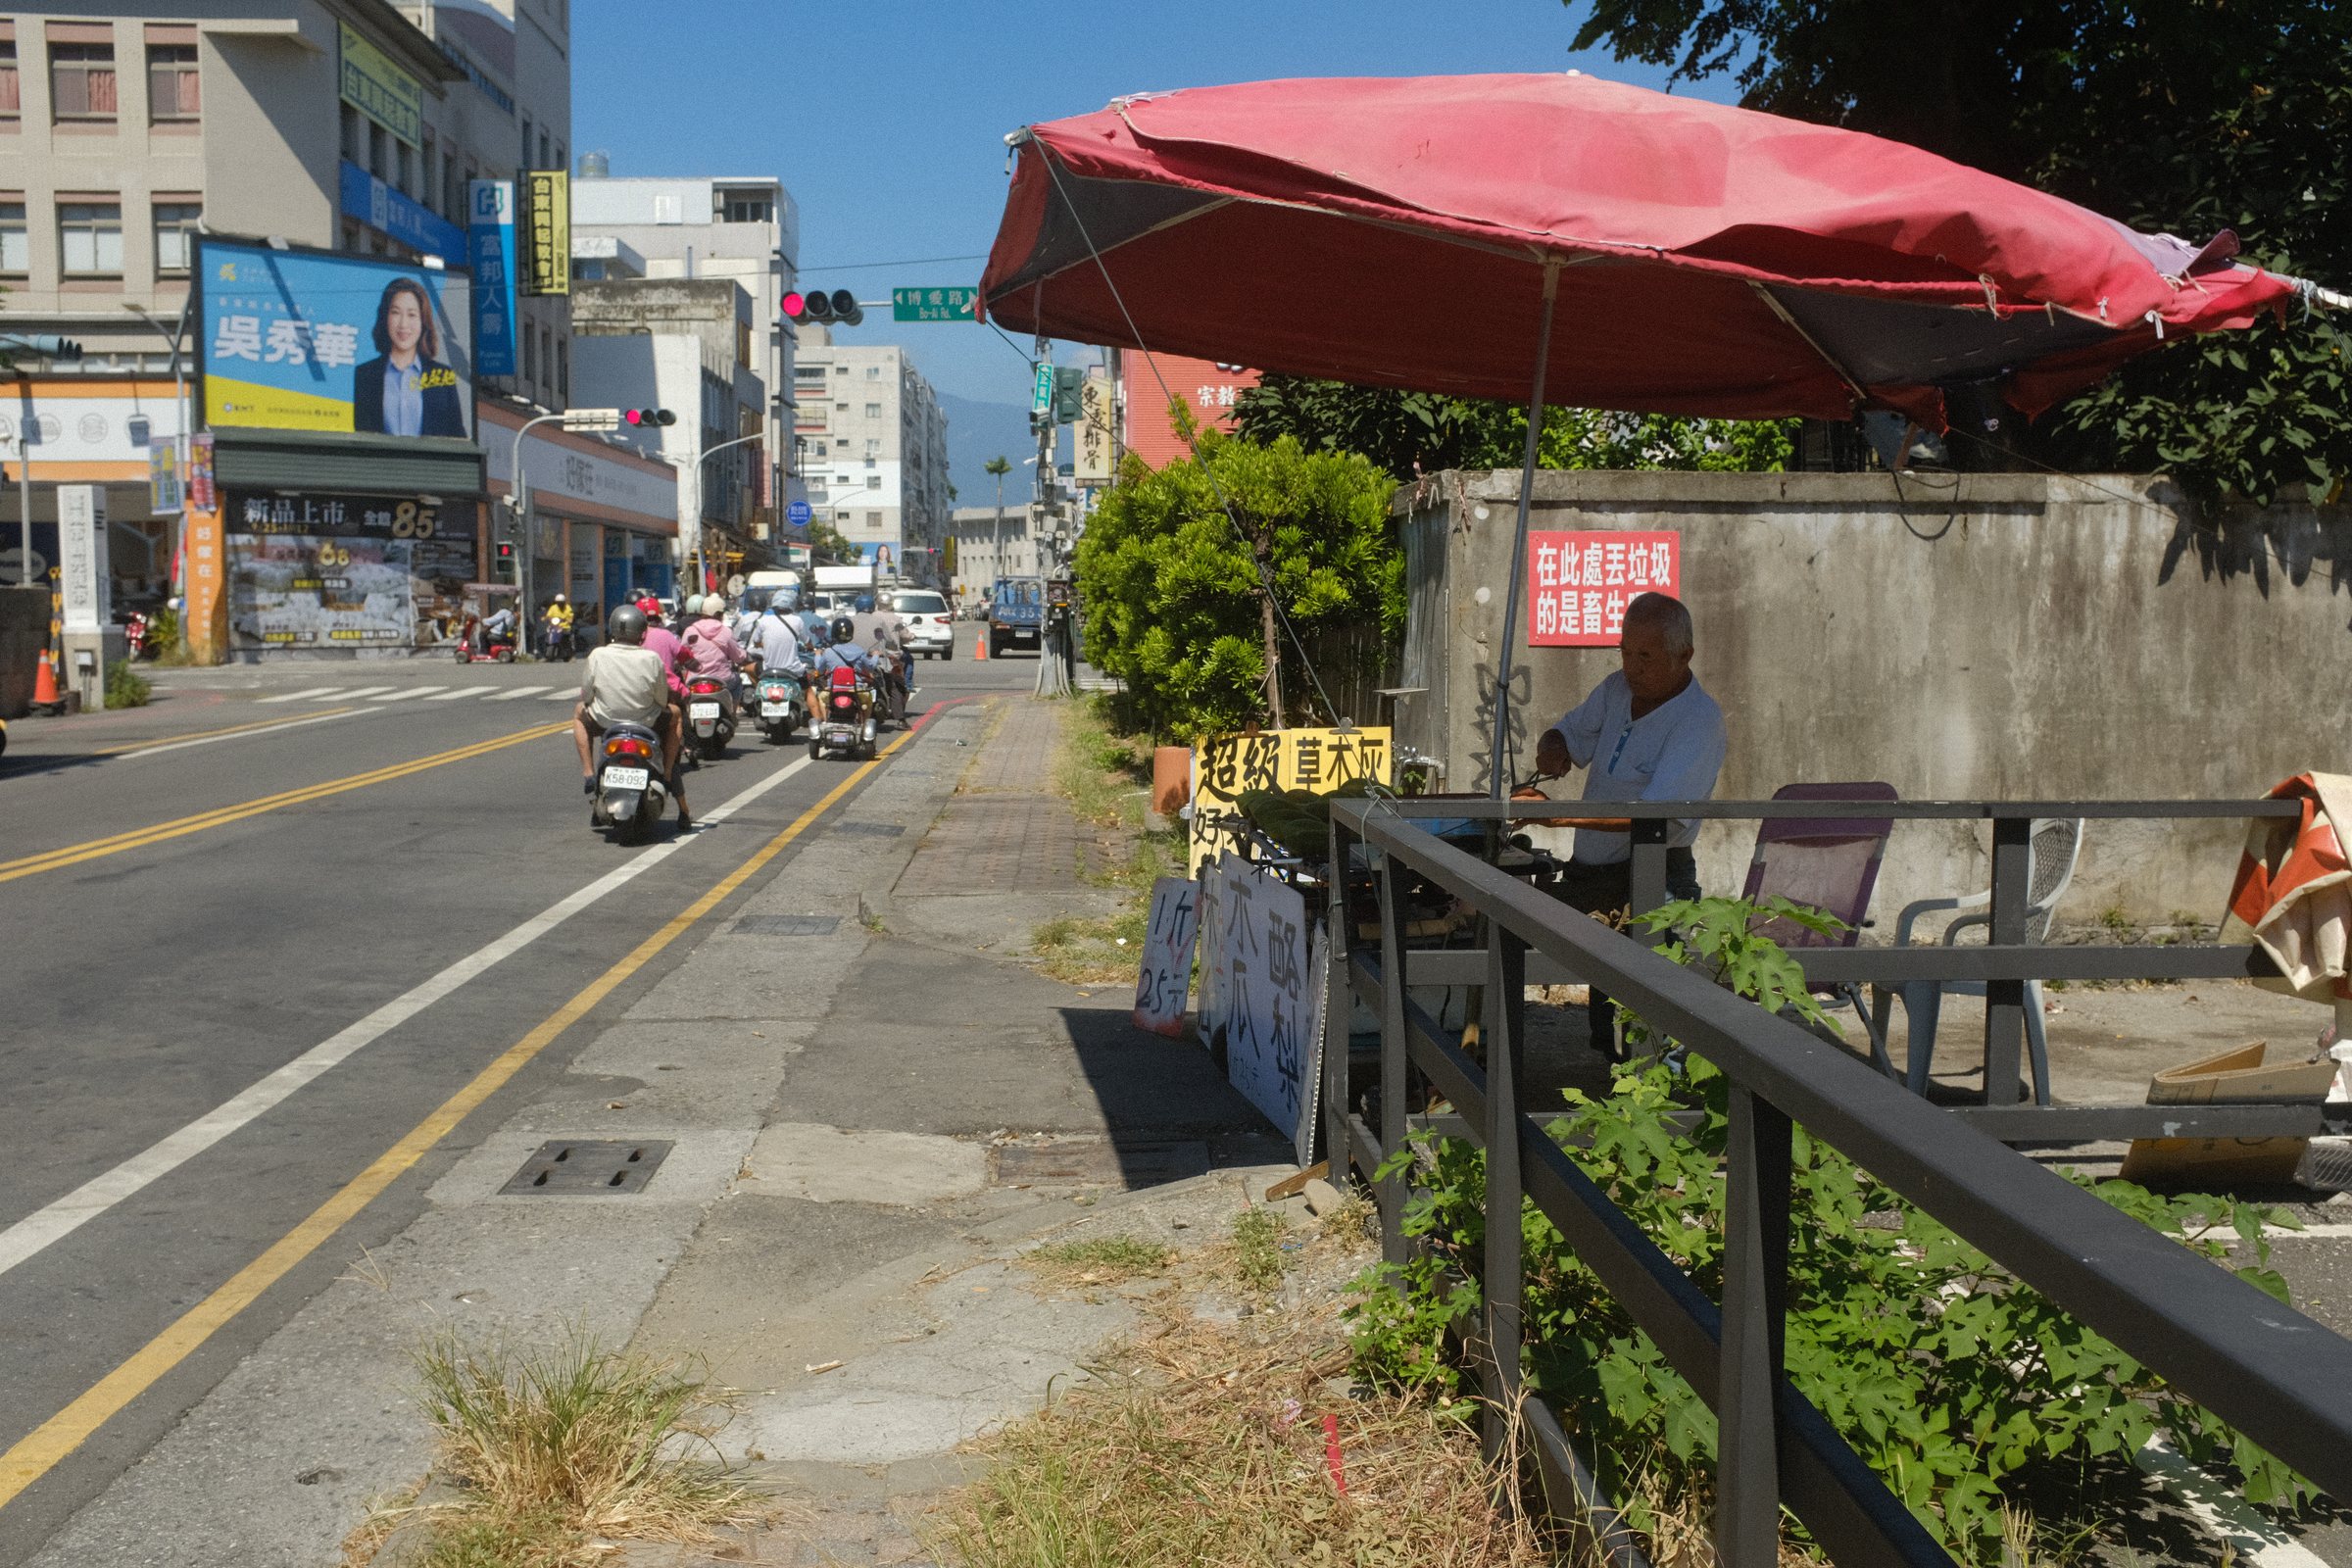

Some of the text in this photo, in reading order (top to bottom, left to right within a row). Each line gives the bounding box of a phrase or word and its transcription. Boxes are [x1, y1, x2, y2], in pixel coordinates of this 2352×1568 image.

[480, 234, 503, 336] 富邦人壽
[907, 290, 962, 306] 博愛路
[215, 315, 359, 368] 吳秀華
[1197, 385, 1245, 408] 宗教
[244, 498, 345, 524] 新品上市
[1537, 542, 1671, 587] 在此處丟垃圾
[1537, 590, 1648, 635] 的是畜生
[606, 773, 646, 786] K58-092
[1197, 734, 1384, 802] 超級 草木灰
[1137, 967, 1184, 1014] 25元
[1228, 877, 1260, 1060] 木瓜
[1268, 908, 1303, 1114] 酪梨
